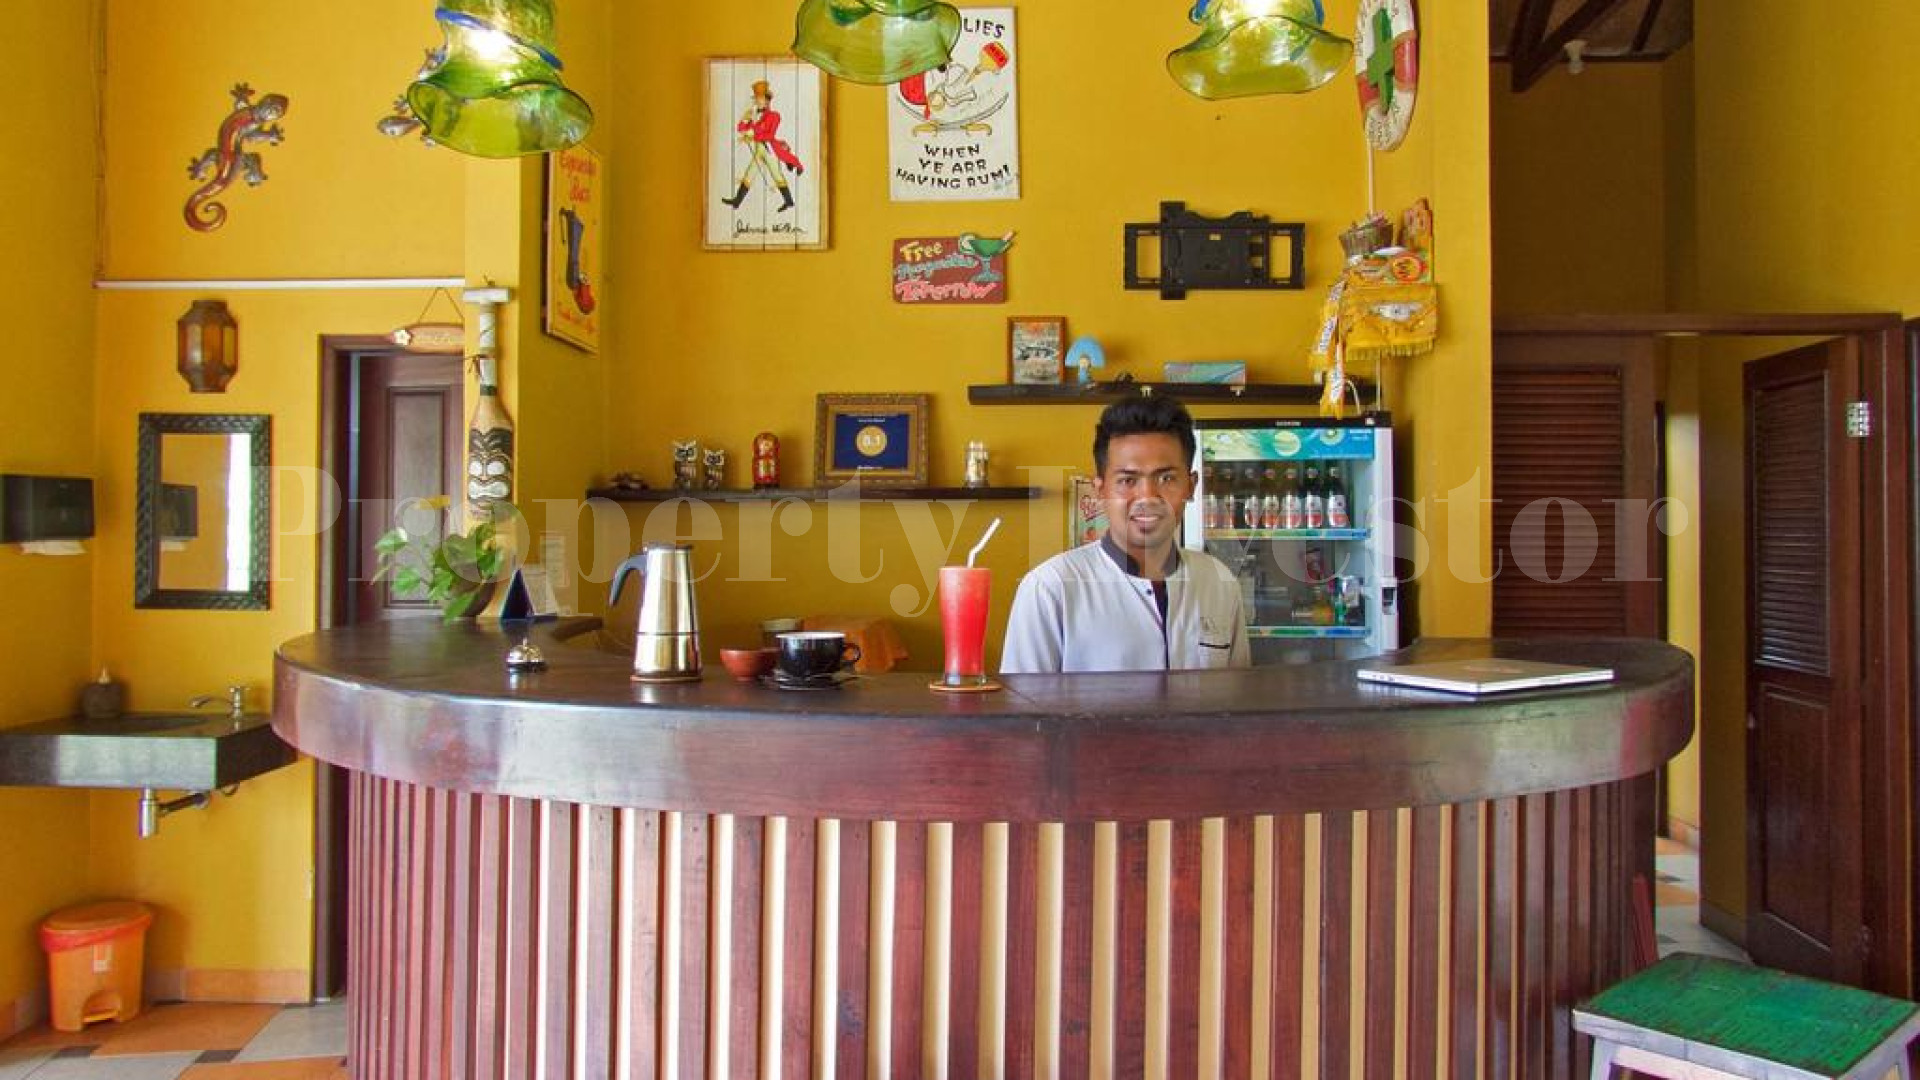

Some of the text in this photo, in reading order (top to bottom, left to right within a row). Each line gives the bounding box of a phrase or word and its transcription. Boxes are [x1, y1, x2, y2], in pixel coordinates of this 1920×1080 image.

[963, 17, 1005, 39] LIES
[924, 143, 980, 158] WHEN
[918, 157, 986, 174] YE ARR
[896, 166, 961, 189] HAVING
[966, 164, 1011, 187] RUM!
[899, 241, 943, 262] Free
